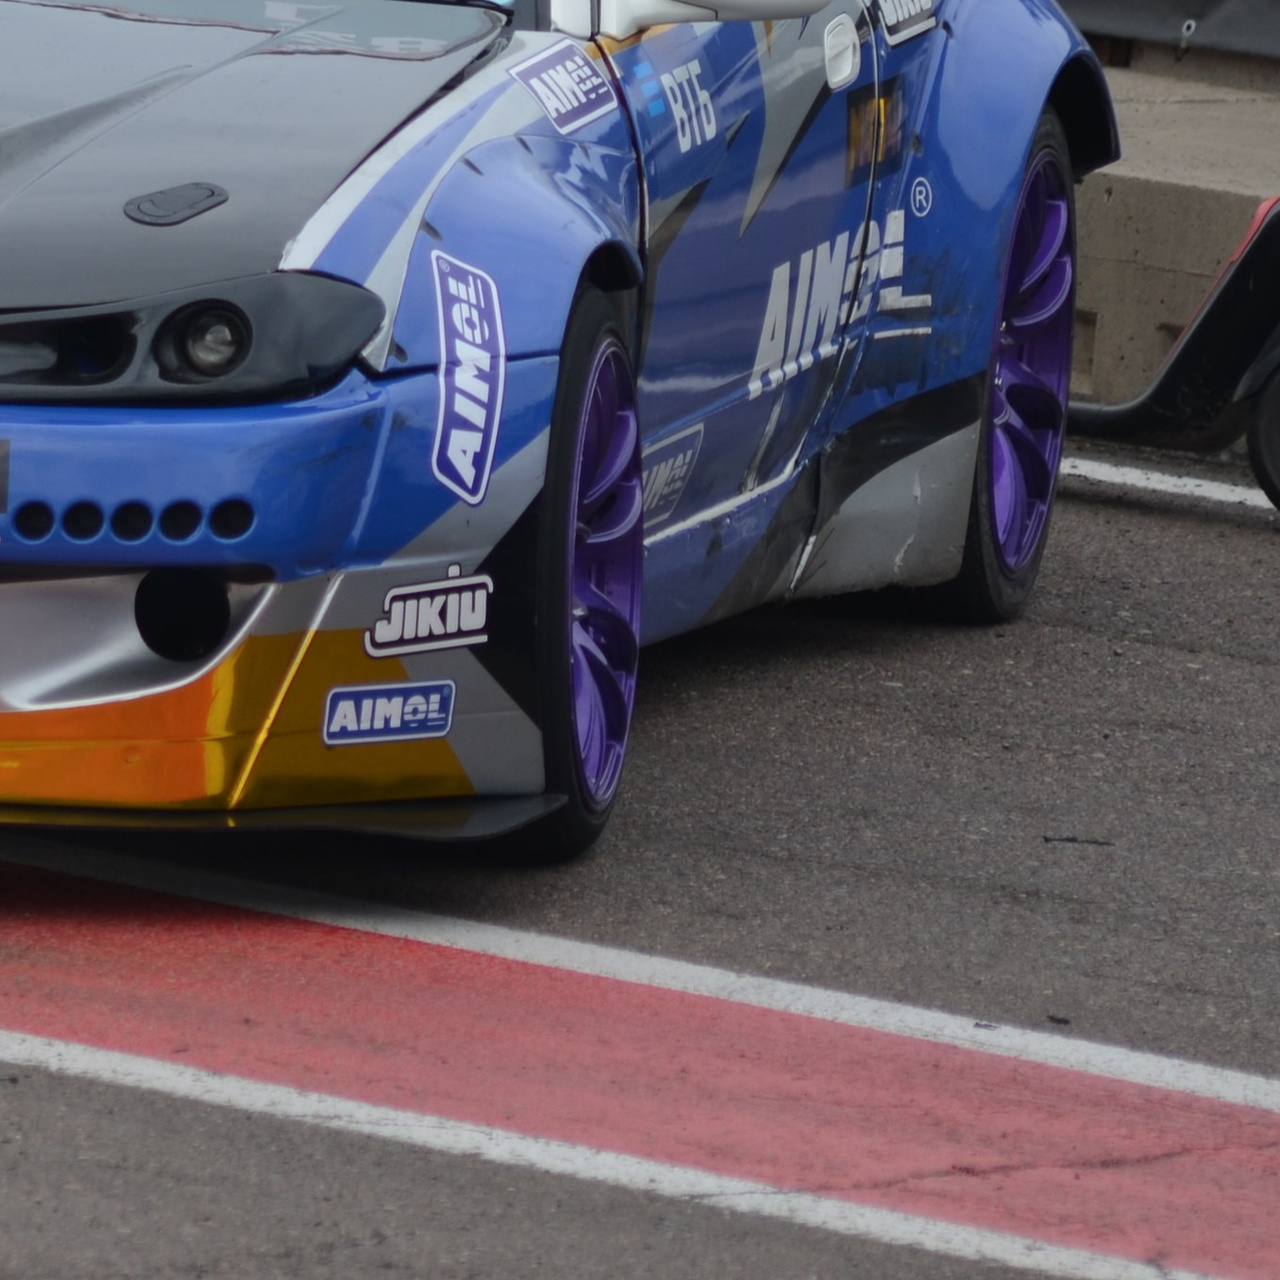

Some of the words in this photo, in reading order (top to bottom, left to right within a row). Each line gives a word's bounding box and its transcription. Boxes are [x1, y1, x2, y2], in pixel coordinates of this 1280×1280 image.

[660, 58, 717, 154] ВТБ
[447, 274, 491, 490] AIMOL
[642, 448, 694, 512] IMOL
[374, 588, 488, 644] JIKIU
[329, 692, 446, 733] AIMOL
